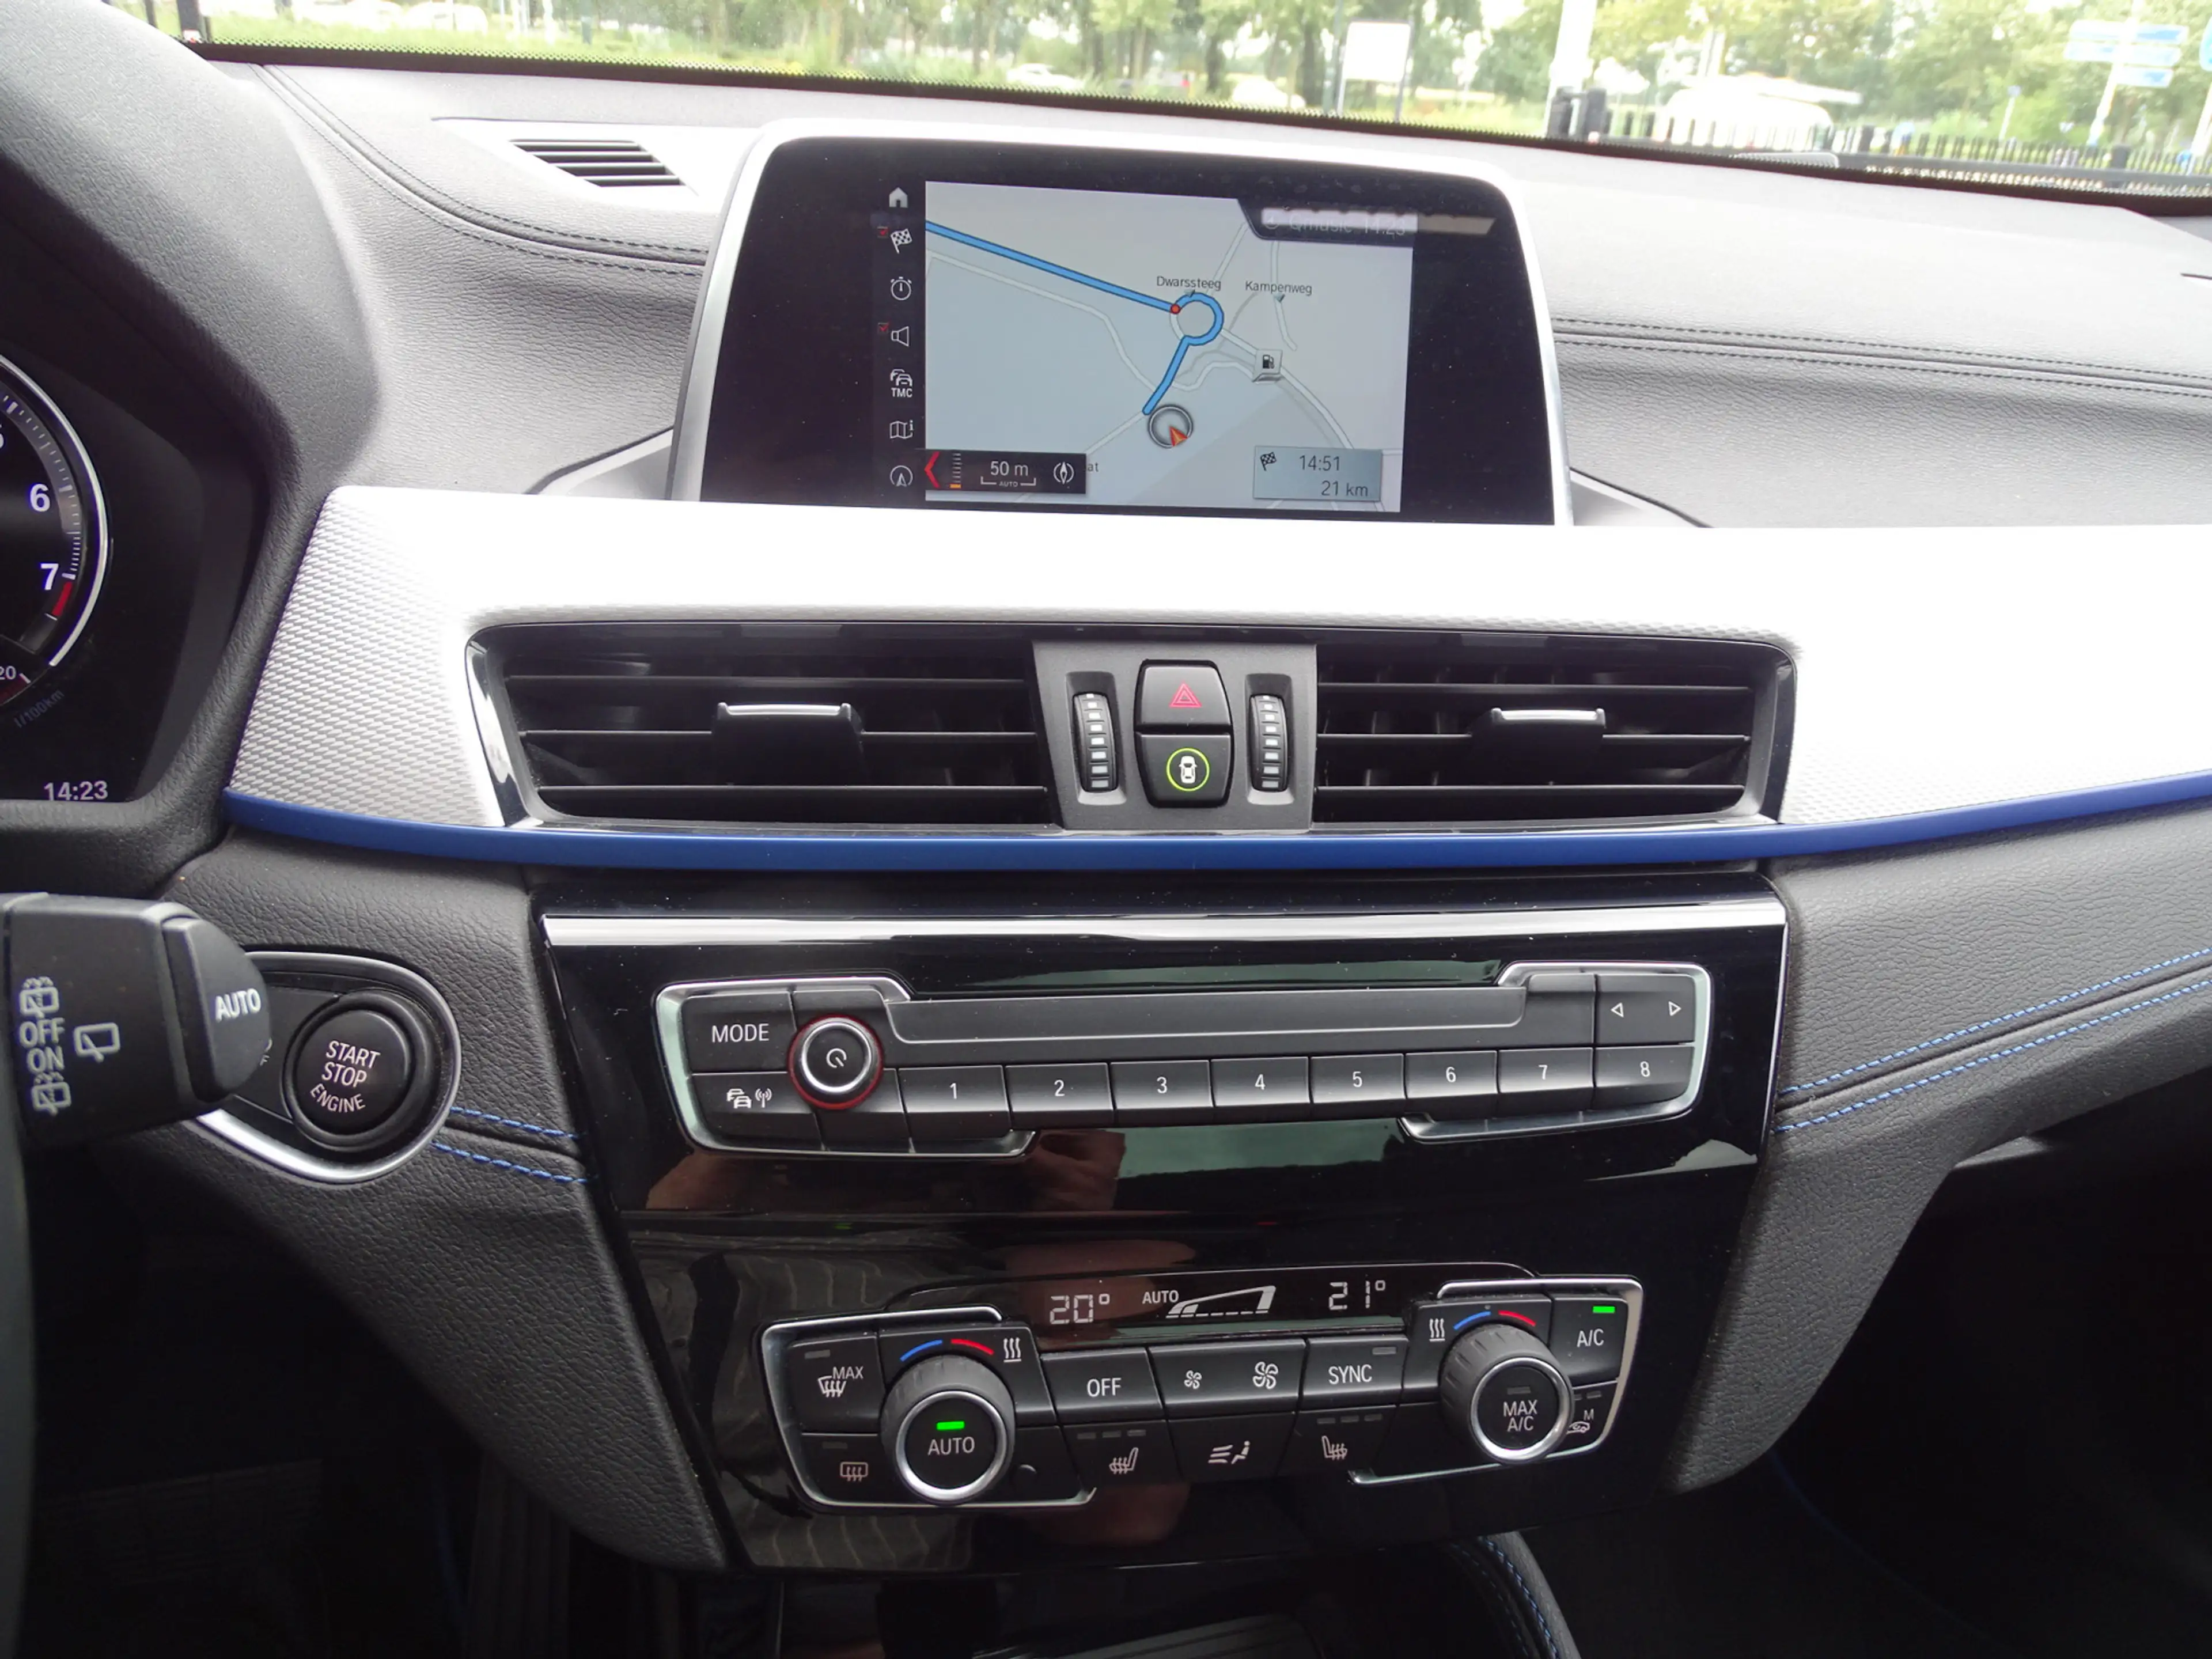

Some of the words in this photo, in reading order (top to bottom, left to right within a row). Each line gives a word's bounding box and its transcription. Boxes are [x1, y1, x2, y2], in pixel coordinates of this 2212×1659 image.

[1157, 276, 1221, 292] Dwarssteeg
[1245, 281, 1313, 297] Kampenweg
[891, 387, 912, 398] TMC
[990, 461, 1009, 476] 50
[1014, 464, 1029, 476] m
[1299, 454, 1340, 471] 14:51
[1321, 480, 1339, 496] 21
[1346, 482, 1369, 497] km
[30, 483, 51, 512] 6
[40, 563, 59, 590] 7
[44, 781, 108, 801] 14:23
[215, 988, 262, 1023] AUTO
[19, 1017, 66, 1048] OFF
[711, 1023, 770, 1043] MODE
[26, 1046, 65, 1074] ON
[325, 1040, 381, 1069] START
[321, 1062, 367, 1088] STOP
[1445, 1066, 1456, 1083] 6
[1538, 1065, 1548, 1080] 7
[1639, 1061, 1651, 1077] 8
[1054, 1080, 1065, 1096] 2
[1156, 1076, 1168, 1093] 3
[1255, 1074, 1266, 1090] 4
[1352, 1071, 1362, 1088] 5
[309, 1083, 366, 1113] ENGINE
[949, 1082, 958, 1099] 1
[1142, 1289, 1179, 1305] AUTO
[1576, 1328, 1604, 1347] A/C
[832, 1366, 864, 1380] MAX
[1328, 1363, 1373, 1385] SYNC
[1086, 1377, 1122, 1397] OFF
[1503, 1399, 1538, 1417] MAX
[1584, 1408, 1594, 1421] M
[1507, 1416, 1534, 1432] A/C
[927, 1436, 975, 1455] AUTO
